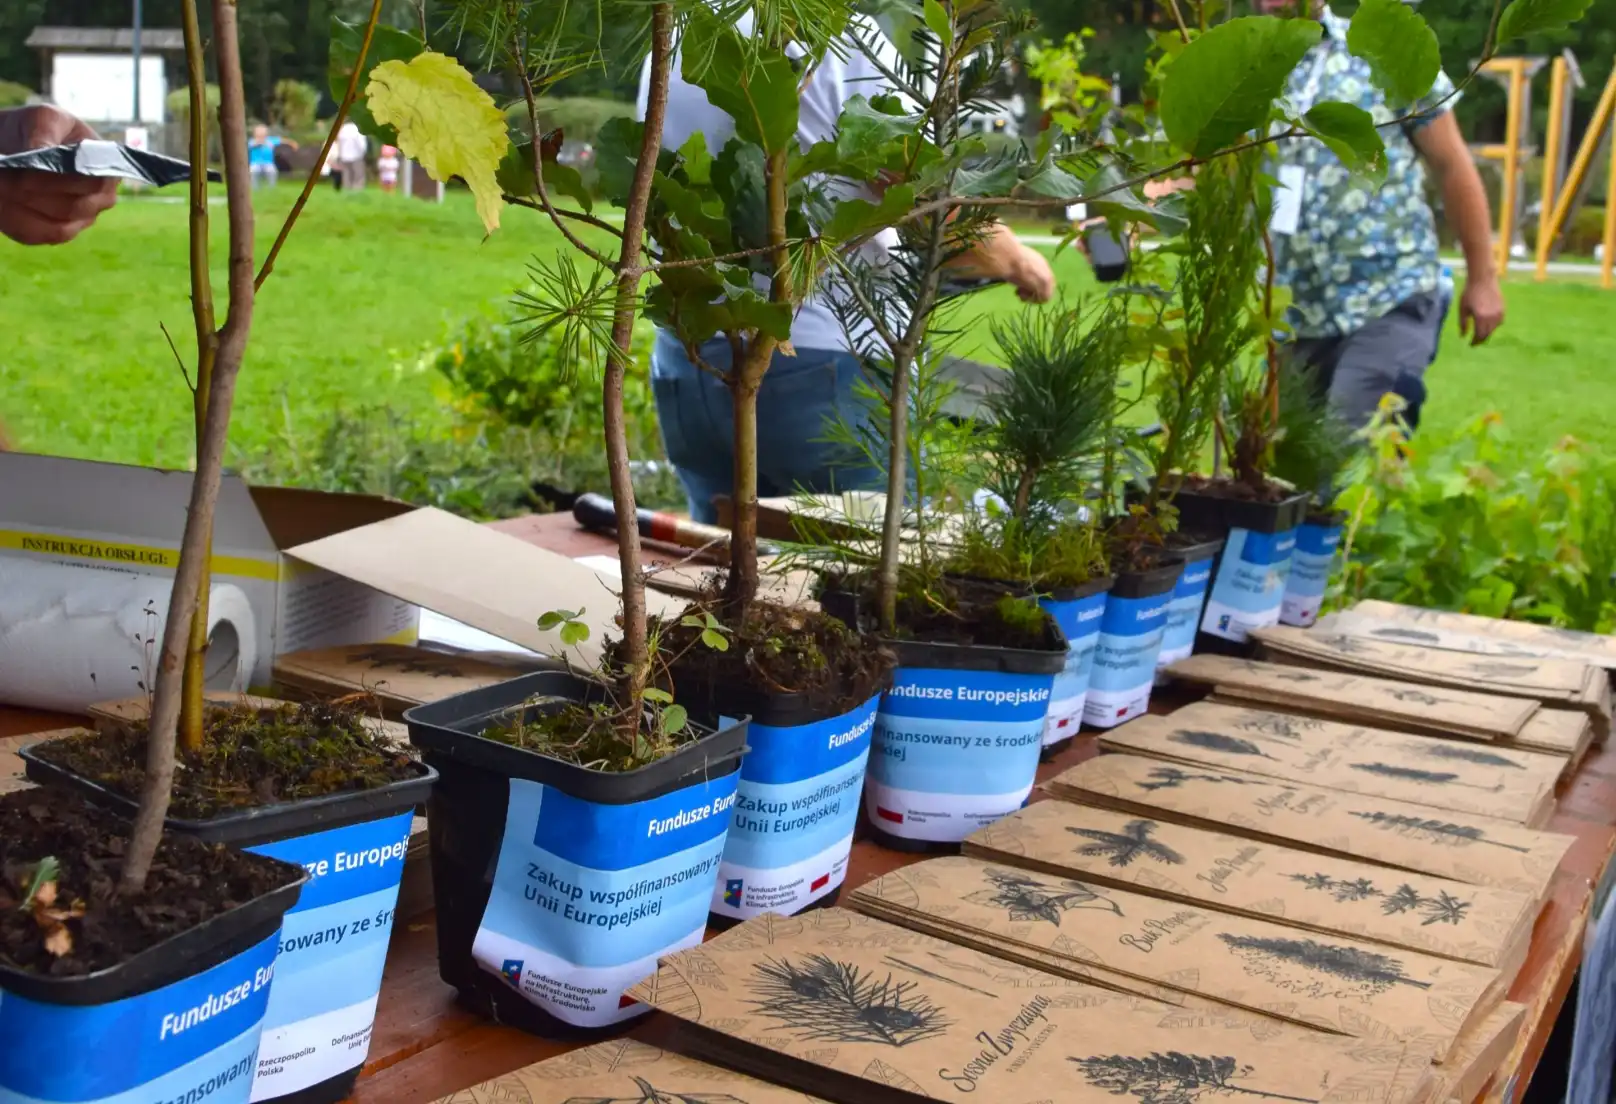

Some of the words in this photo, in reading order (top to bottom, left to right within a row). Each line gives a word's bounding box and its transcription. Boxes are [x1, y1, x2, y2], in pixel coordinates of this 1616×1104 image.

[22, 537, 101, 558] INSTRUKCJA
[104, 547, 168, 565] OBSŁUGI:
[957, 686, 1049, 706] Europejskie
[975, 738, 991, 747] ze
[735, 795, 788, 816] Zakup
[735, 814, 769, 833] Unii
[773, 798, 841, 833] Europejskiej
[647, 805, 711, 838] Fundusze
[527, 862, 583, 900] Zakup
[589, 857, 713, 907] współfinansowany
[524, 883, 558, 913] Unii
[563, 895, 663, 931] Europejskiej
[350, 918, 370, 936] ze
[1118, 927, 1162, 954] Buk
[527, 969, 562, 987] Fundusze
[563, 983, 608, 996] Europejskie
[160, 979, 251, 1041] Fundusze
[551, 995, 596, 1012] Środowisko
[258, 1046, 316, 1068] Rzeczpospolita
[938, 1050, 999, 1093] Sosna
[975, 994, 1053, 1056] Zwyczajna
[257, 1066, 284, 1078] Polska
